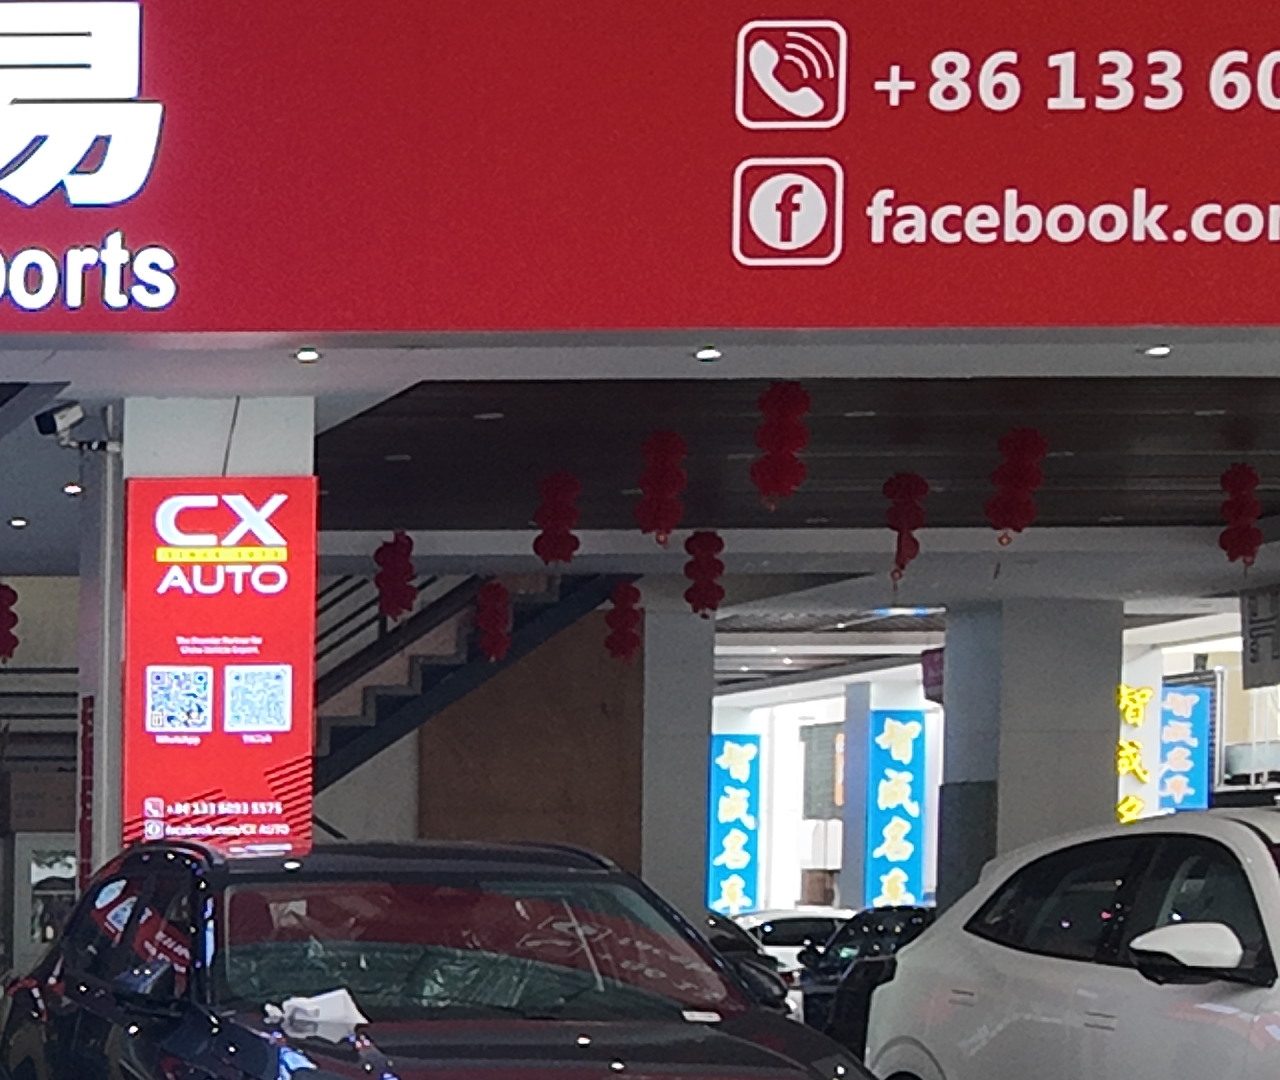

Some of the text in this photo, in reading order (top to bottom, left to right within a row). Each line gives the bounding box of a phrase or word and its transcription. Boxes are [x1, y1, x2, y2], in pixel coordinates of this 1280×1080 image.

[874, 50, 1022, 112] +86
[1046, 50, 1184, 112] 133
[866, 188, 1280, 244] facebook.co
[155, 494, 289, 546] CX
[156, 565, 289, 594] AUTO
